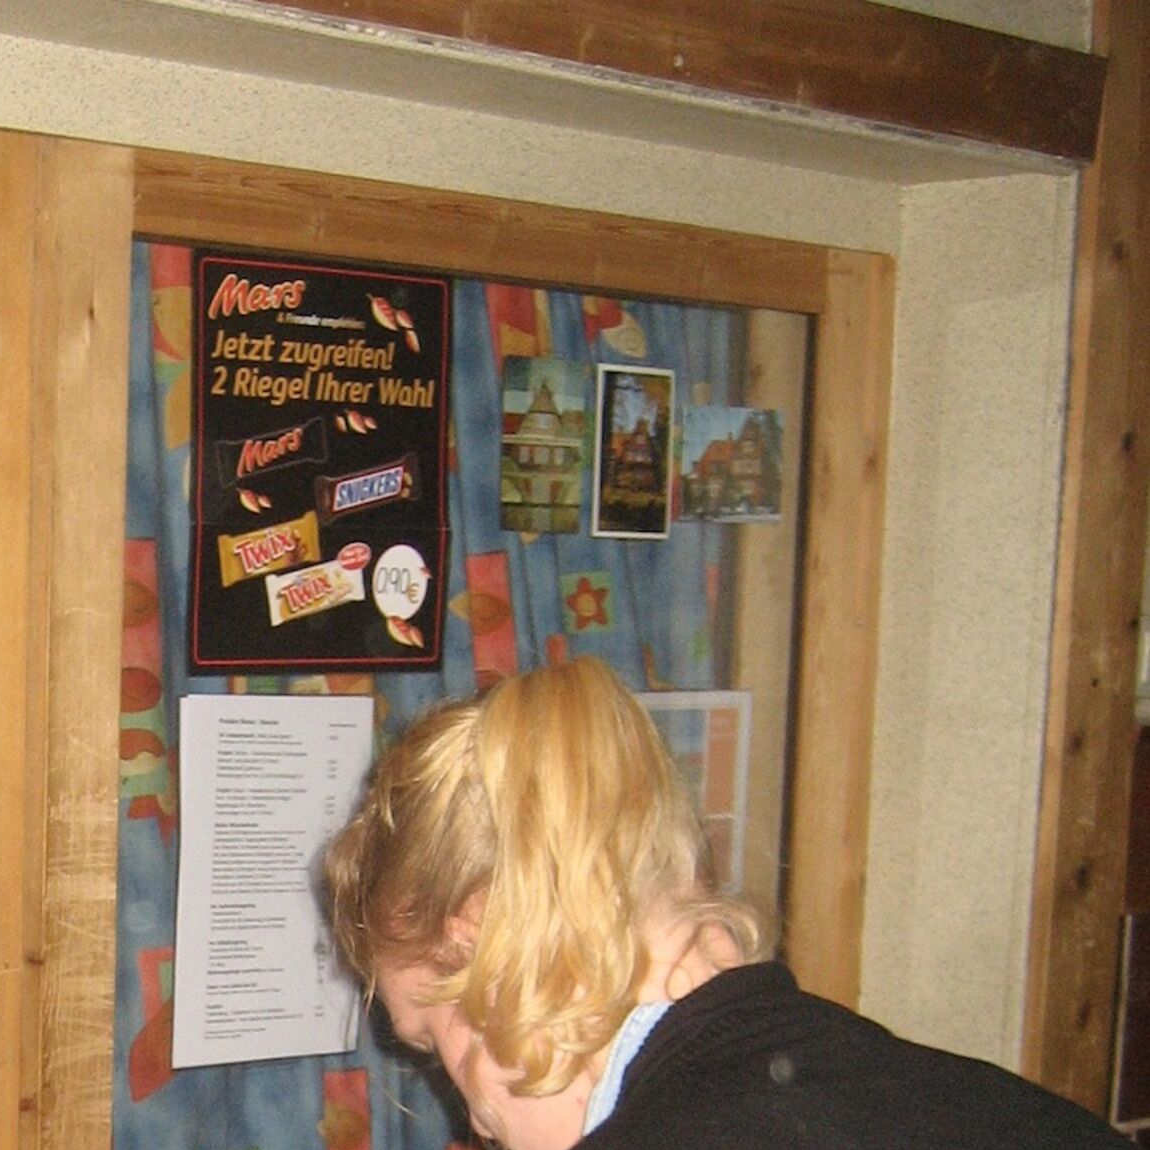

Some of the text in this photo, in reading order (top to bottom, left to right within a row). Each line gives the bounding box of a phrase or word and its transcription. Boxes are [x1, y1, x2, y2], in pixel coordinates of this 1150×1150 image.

[208, 273, 306, 319] Mars
[211, 330, 396, 373] Jetzt zugreifen!
[211, 366, 434, 408] 2 Riegel Ihrer Wahl
[237, 428, 303, 478] Mars
[336, 468, 401, 508] SNICKERS
